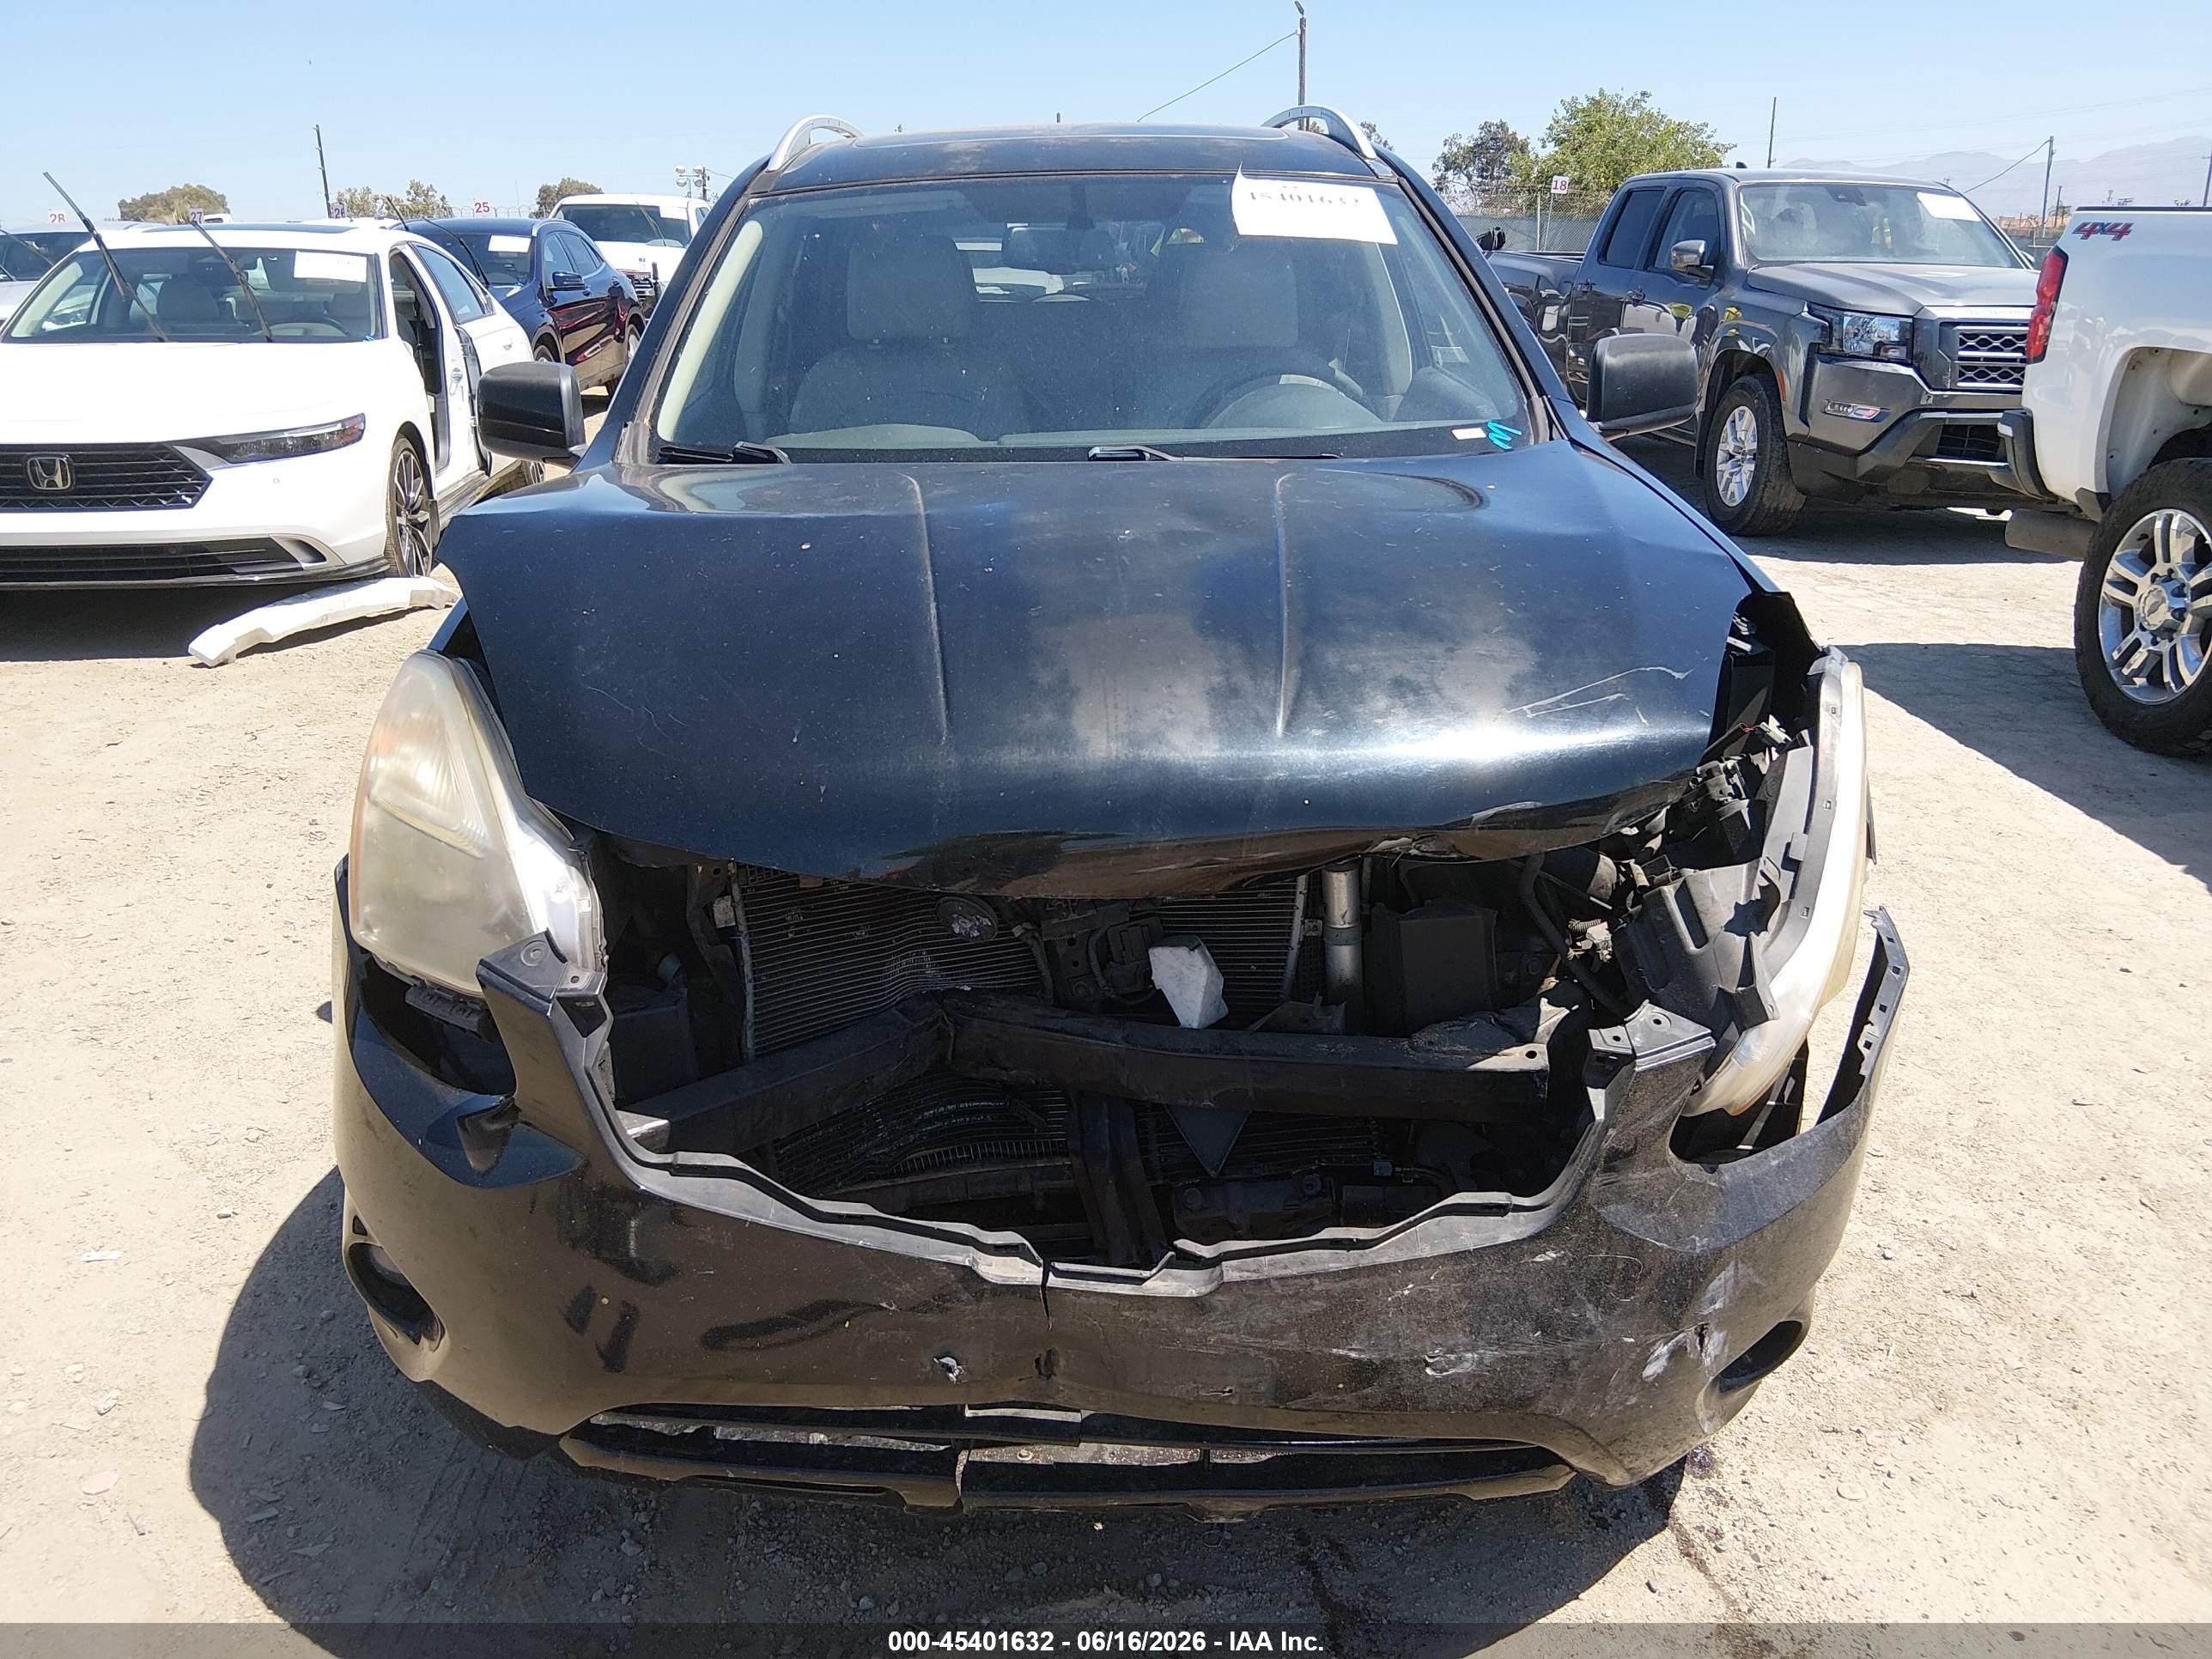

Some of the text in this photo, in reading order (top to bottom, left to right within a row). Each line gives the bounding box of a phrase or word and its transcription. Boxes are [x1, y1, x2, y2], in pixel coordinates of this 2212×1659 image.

[1553, 179, 1567, 191] 18
[474, 202, 490, 214] 25
[191, 211, 203, 224] 27
